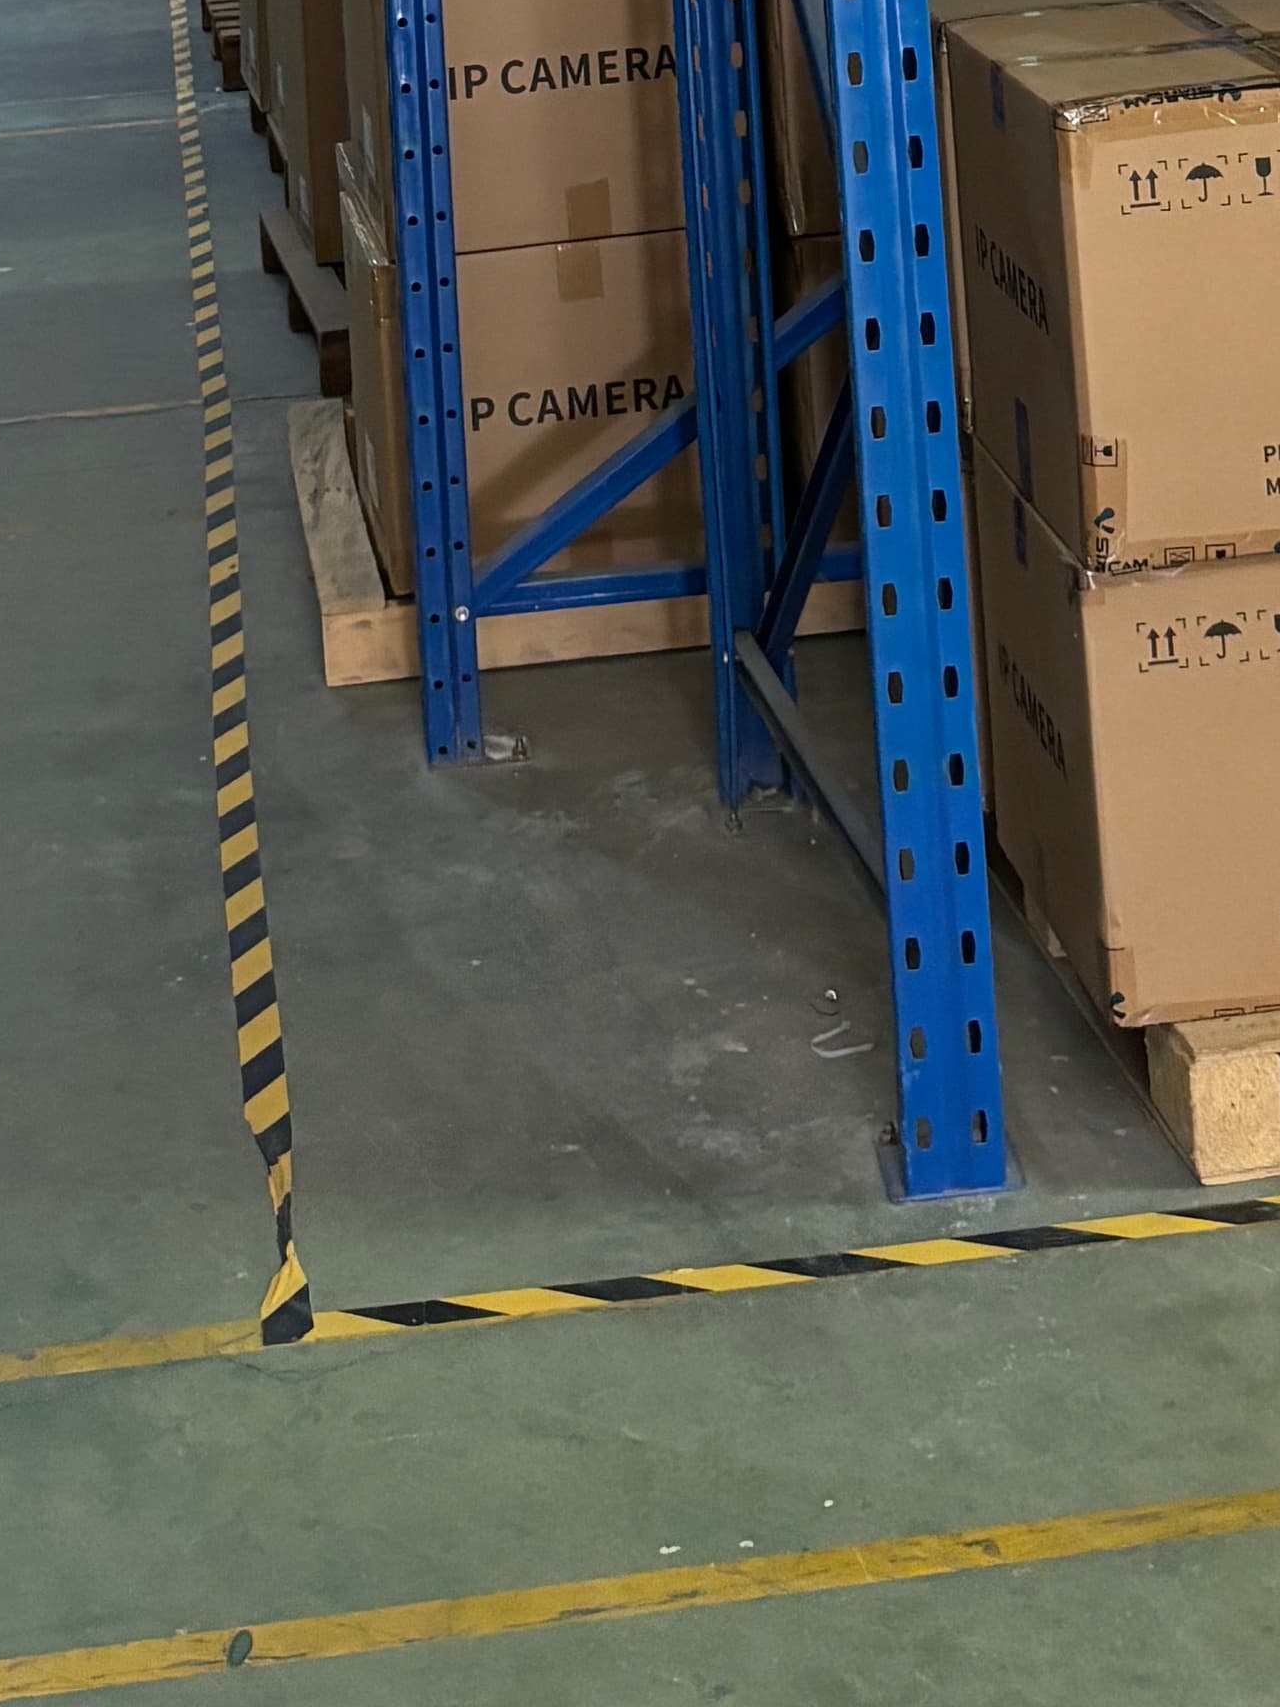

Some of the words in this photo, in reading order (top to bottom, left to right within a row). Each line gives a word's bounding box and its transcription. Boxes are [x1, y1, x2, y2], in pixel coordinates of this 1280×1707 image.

[448, 63, 484, 102] IP
[499, 45, 678, 94] CAMERA
[990, 240, 1049, 337] CAMERA
[508, 372, 686, 427] CAMERA
